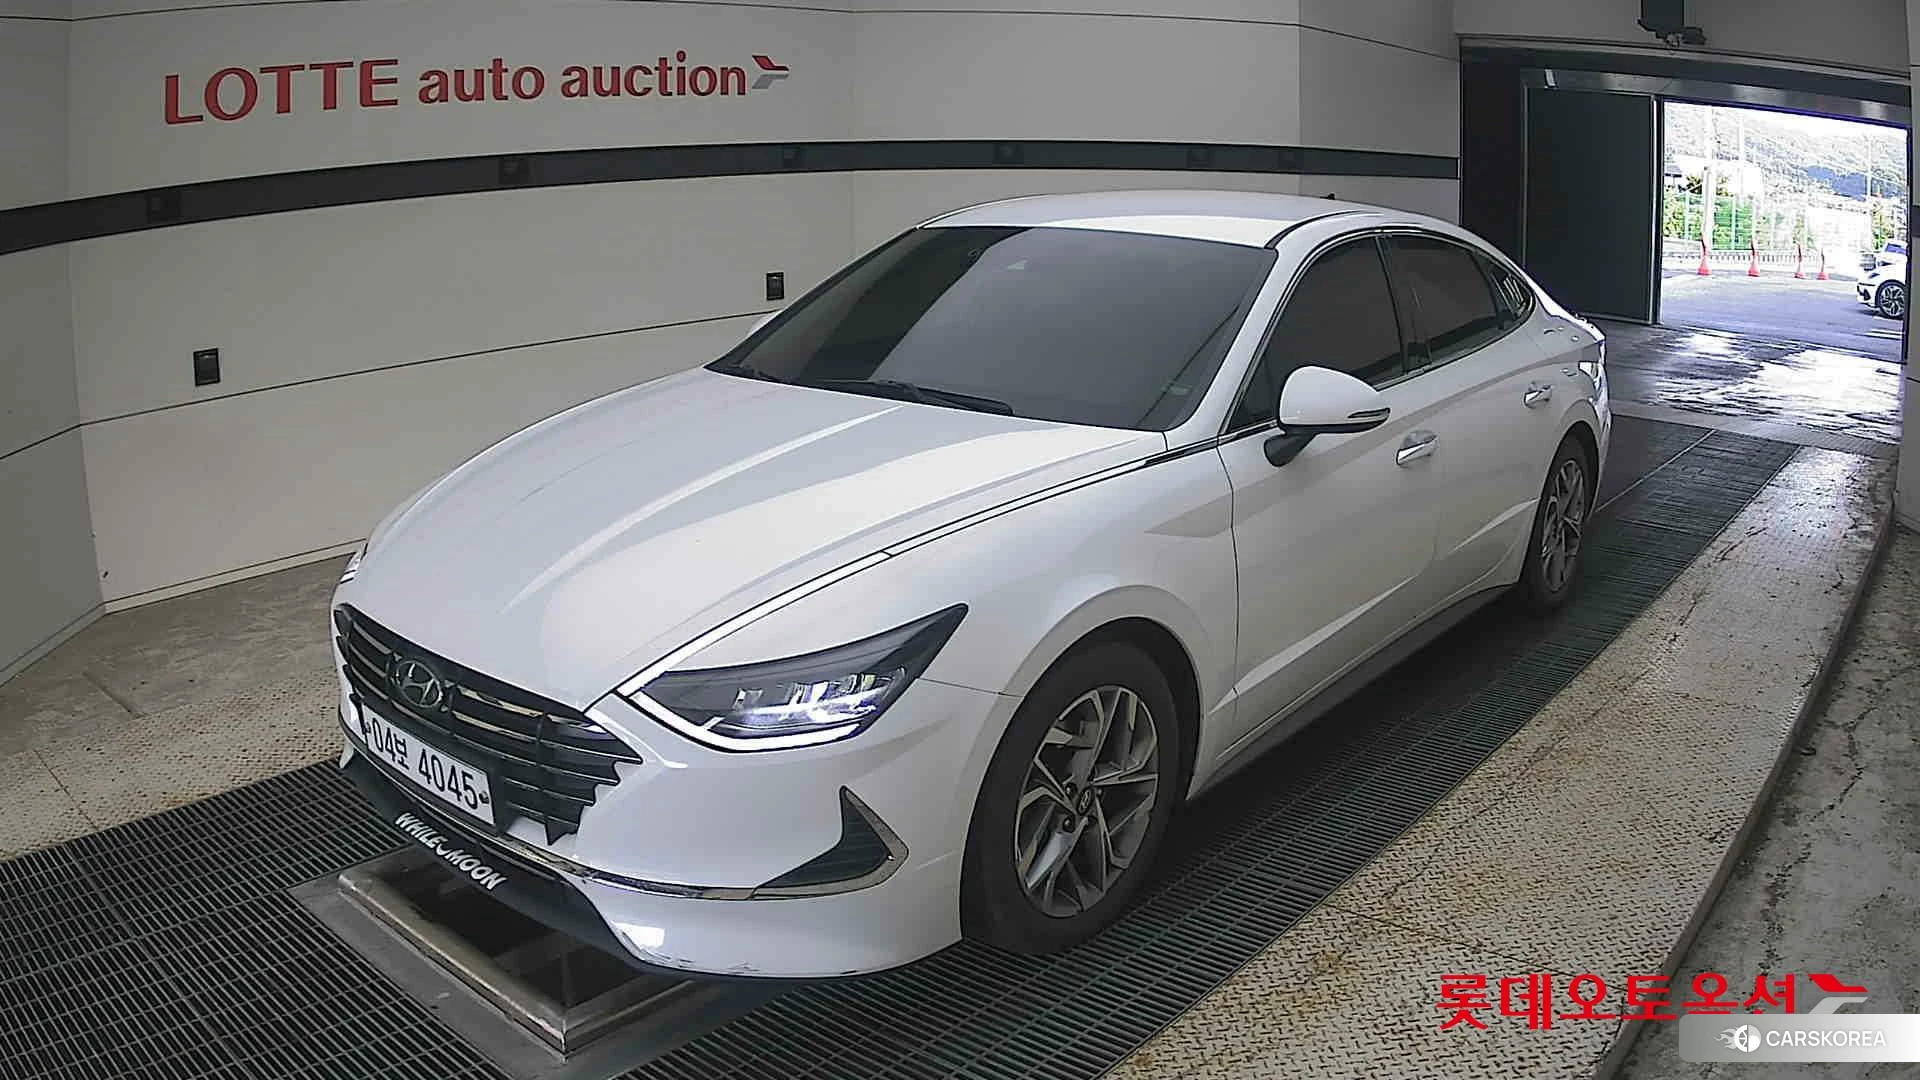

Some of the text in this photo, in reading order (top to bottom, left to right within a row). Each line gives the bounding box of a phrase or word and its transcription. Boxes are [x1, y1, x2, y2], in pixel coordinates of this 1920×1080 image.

[165, 50, 747, 125] LOTTE auto auction
[372, 719, 478, 809] 04보 4045
